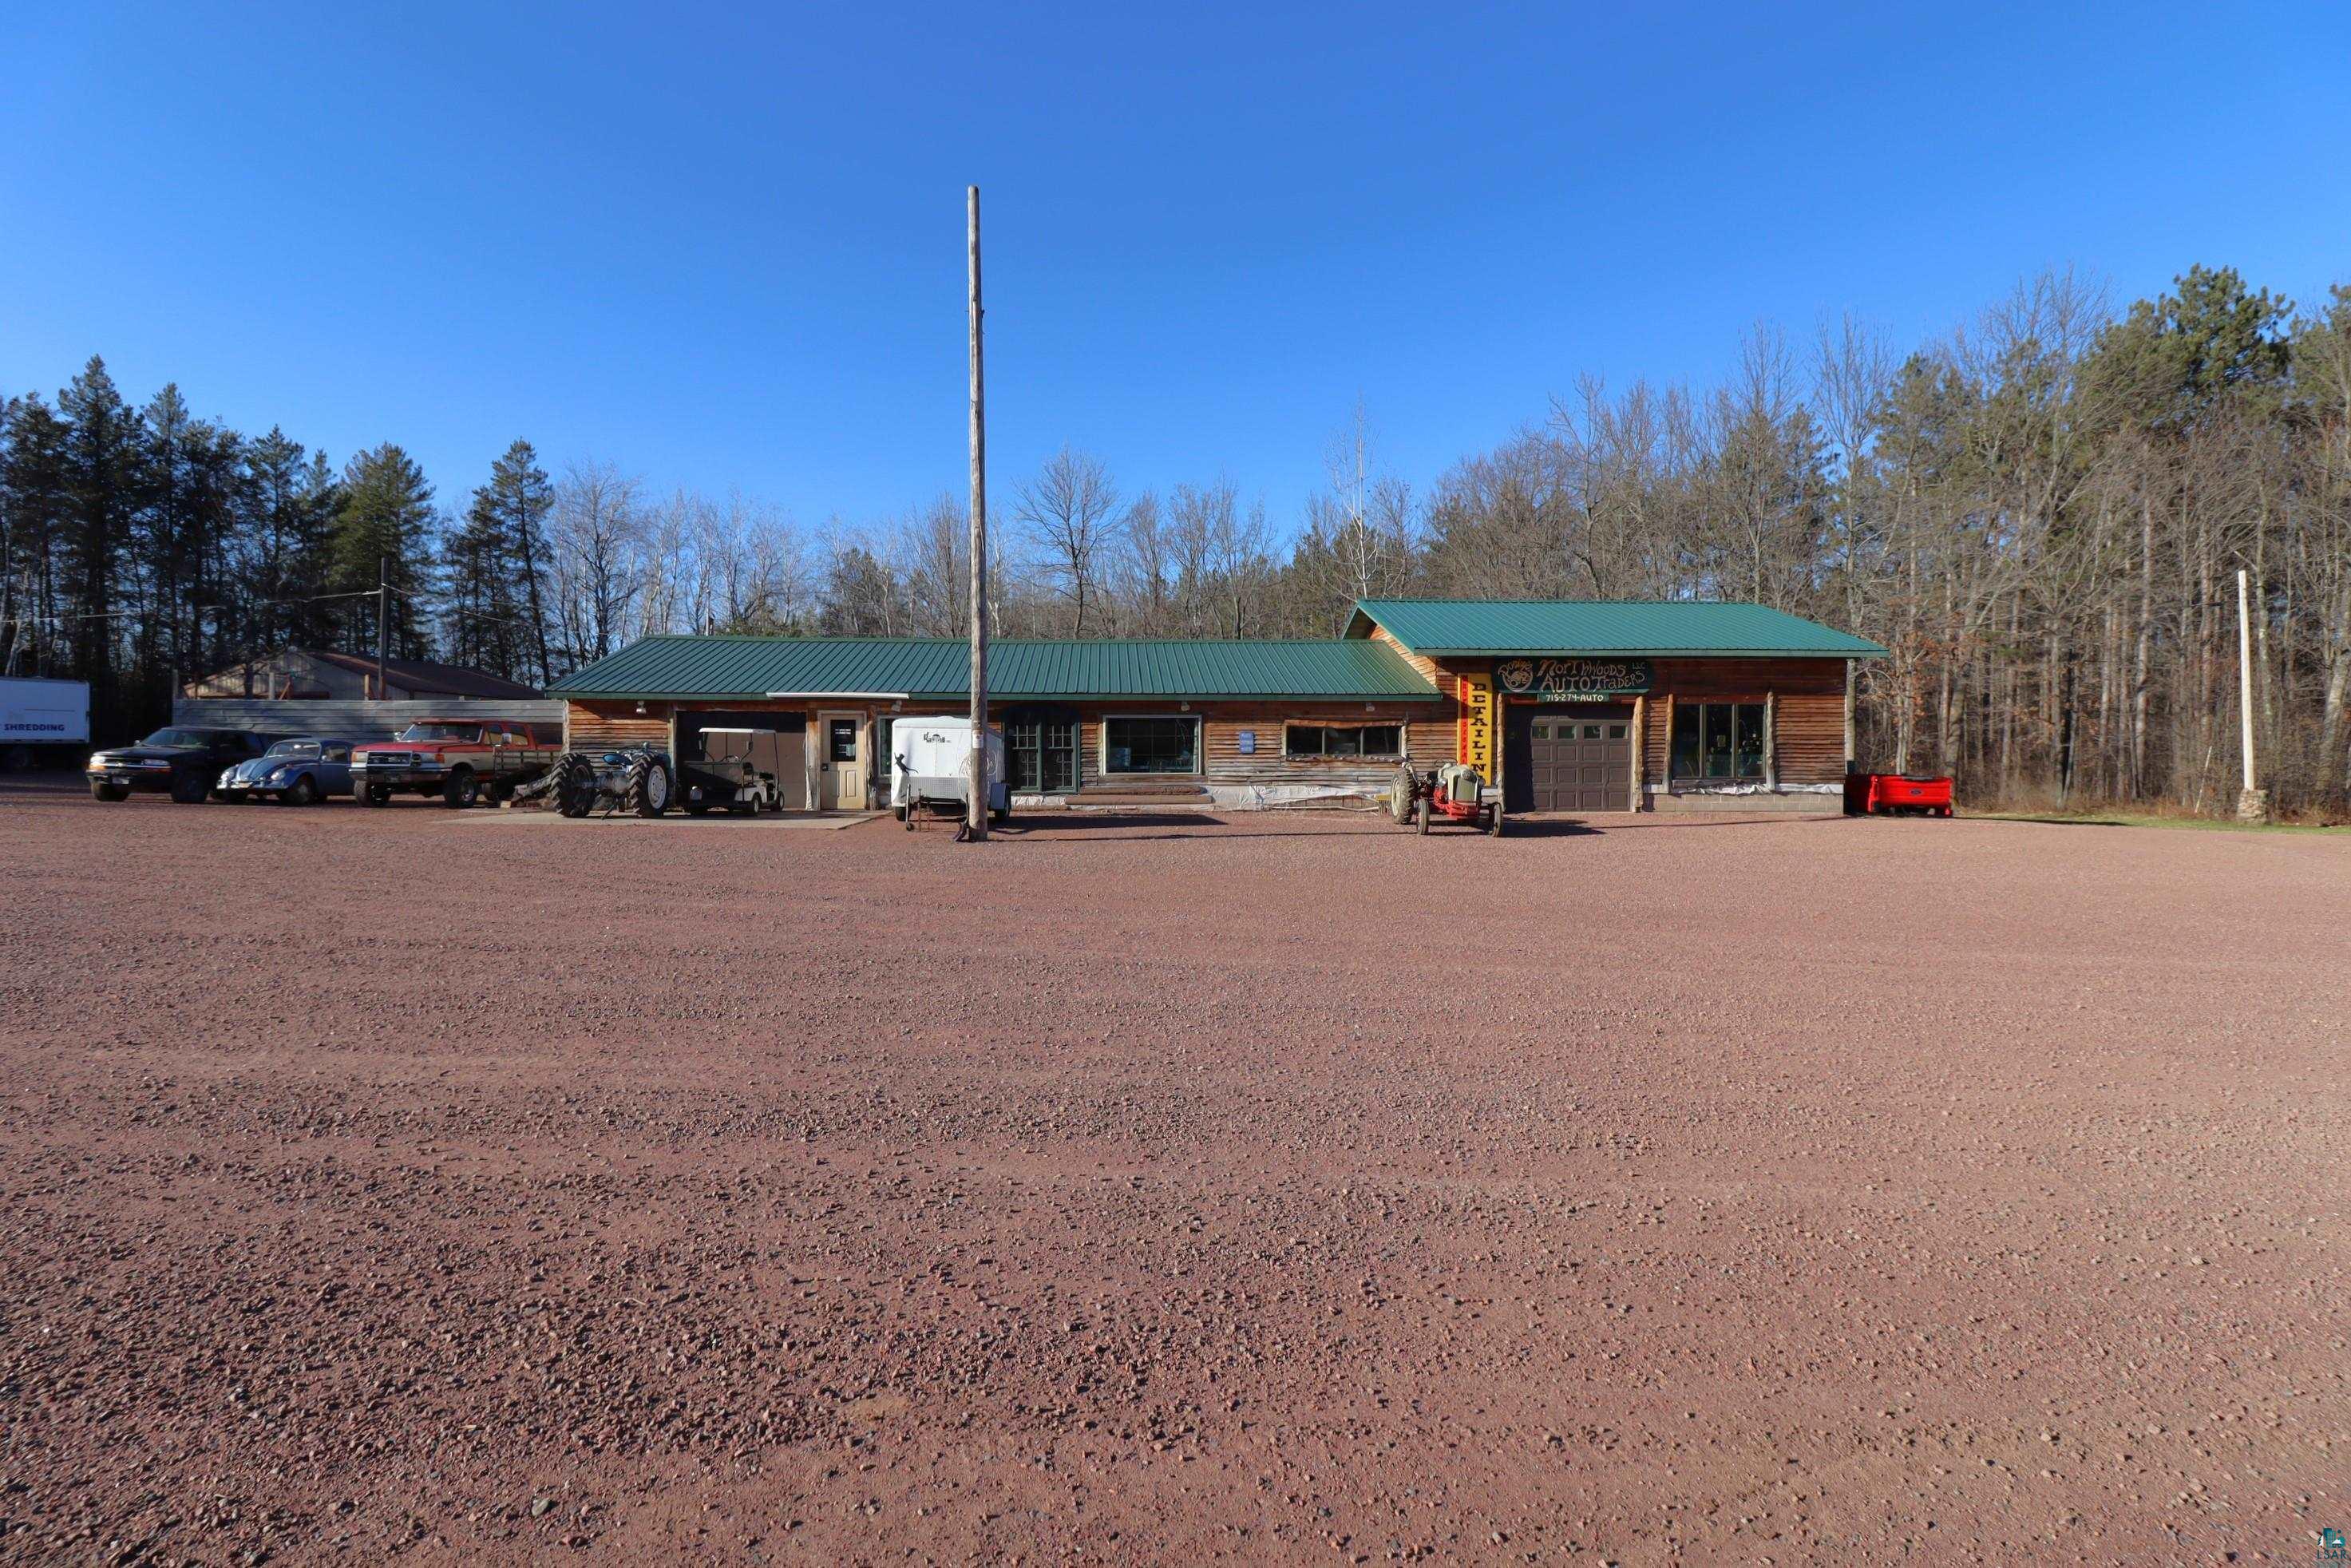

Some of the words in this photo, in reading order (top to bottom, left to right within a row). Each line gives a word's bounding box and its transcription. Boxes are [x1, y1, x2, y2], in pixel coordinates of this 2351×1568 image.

[1539, 674, 1590, 692] AUTO
[1546, 693, 1604, 703] 715-274-AUTO
[1470, 683, 1488, 779] DETAILIN
